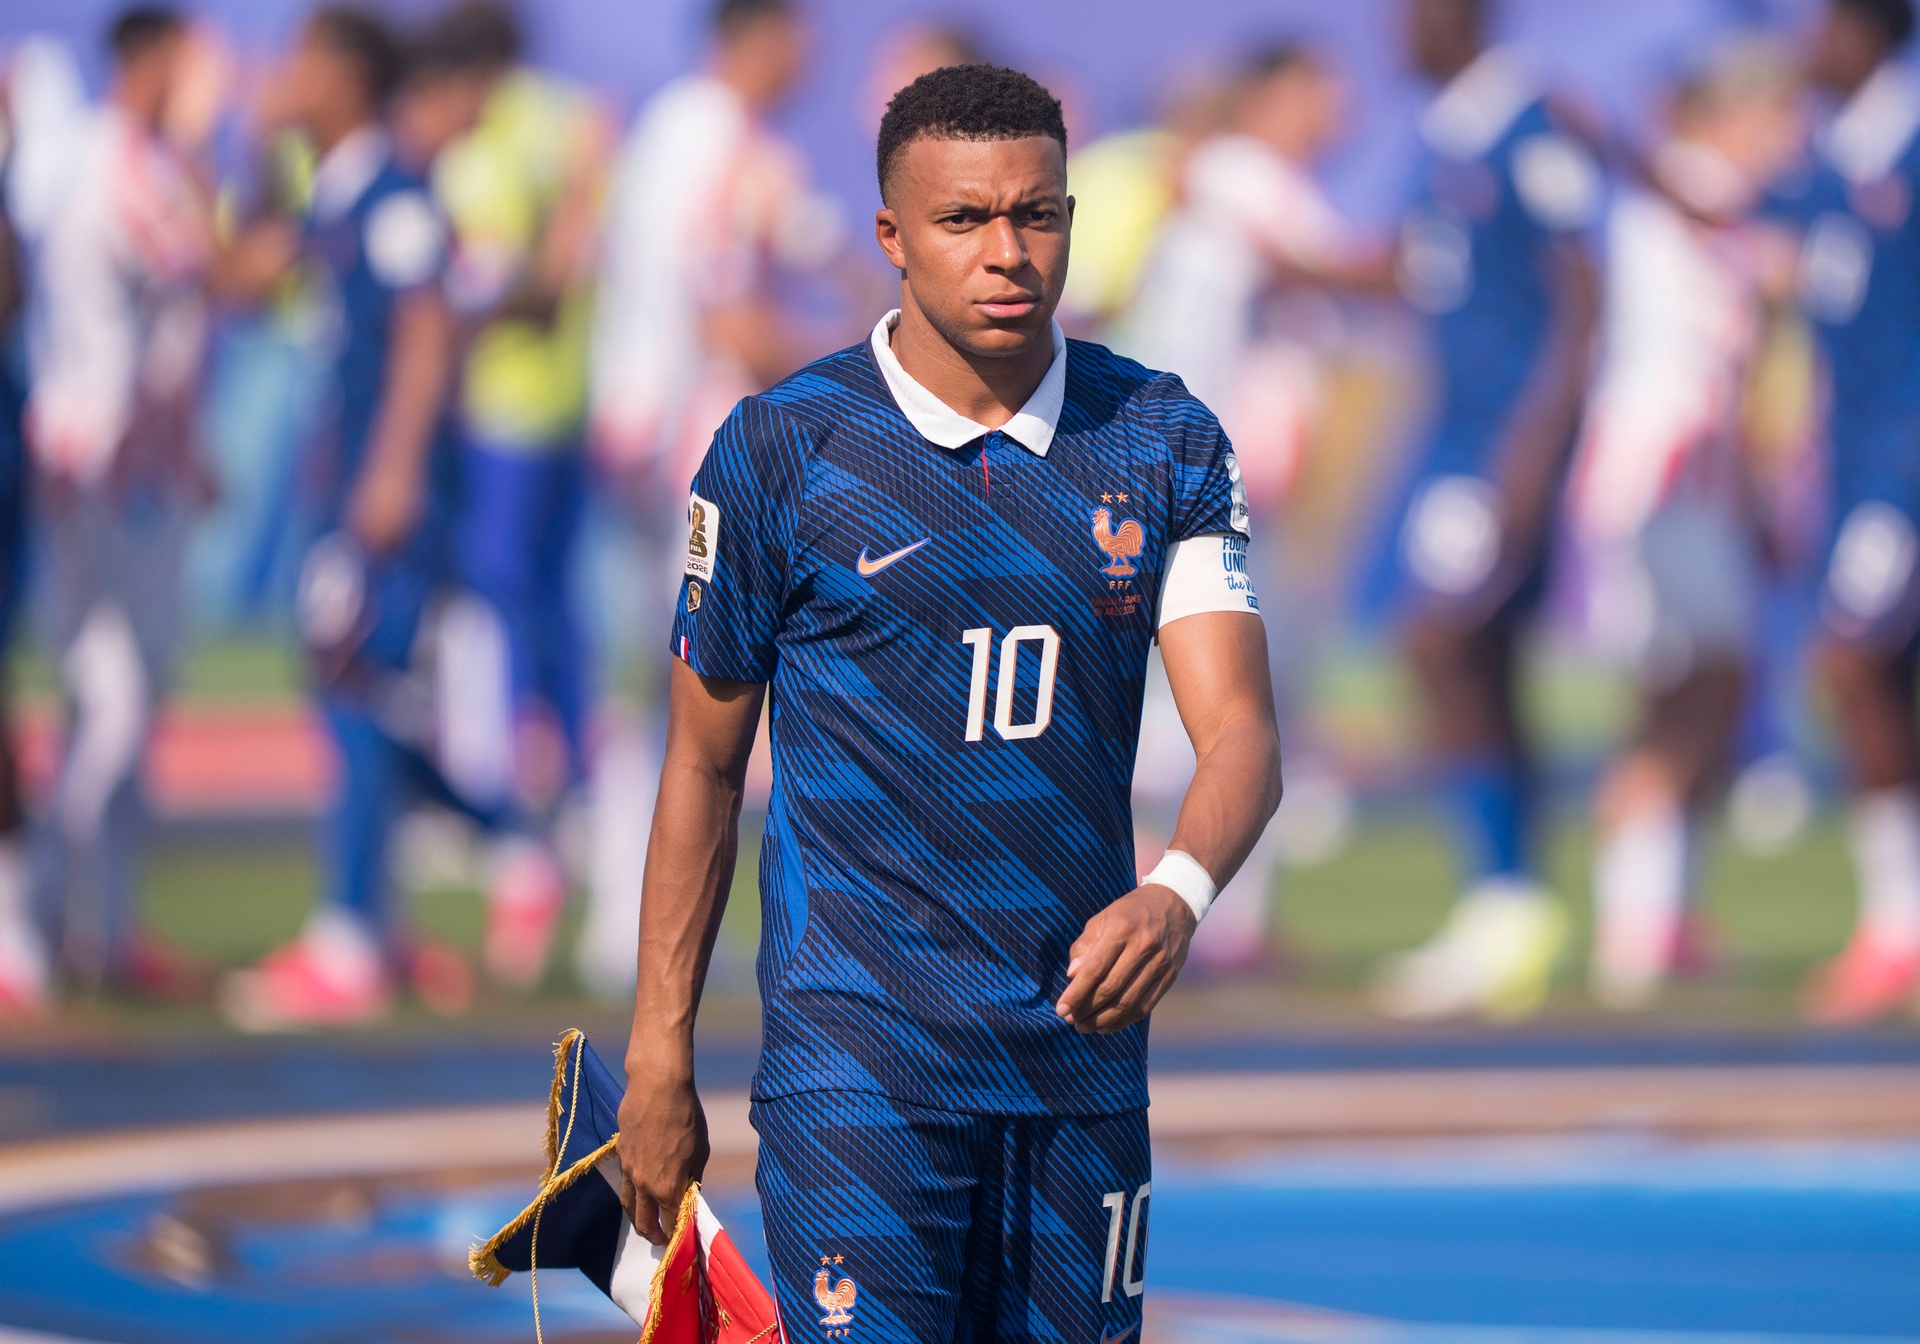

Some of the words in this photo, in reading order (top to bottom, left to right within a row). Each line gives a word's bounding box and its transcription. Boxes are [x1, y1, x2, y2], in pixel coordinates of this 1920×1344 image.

[690, 545, 702, 553] FIFA
[687, 562, 708, 575] 2026
[1224, 574, 1245, 590] the
[962, 624, 1061, 741] 10
[1101, 1181, 1151, 1303] 10
